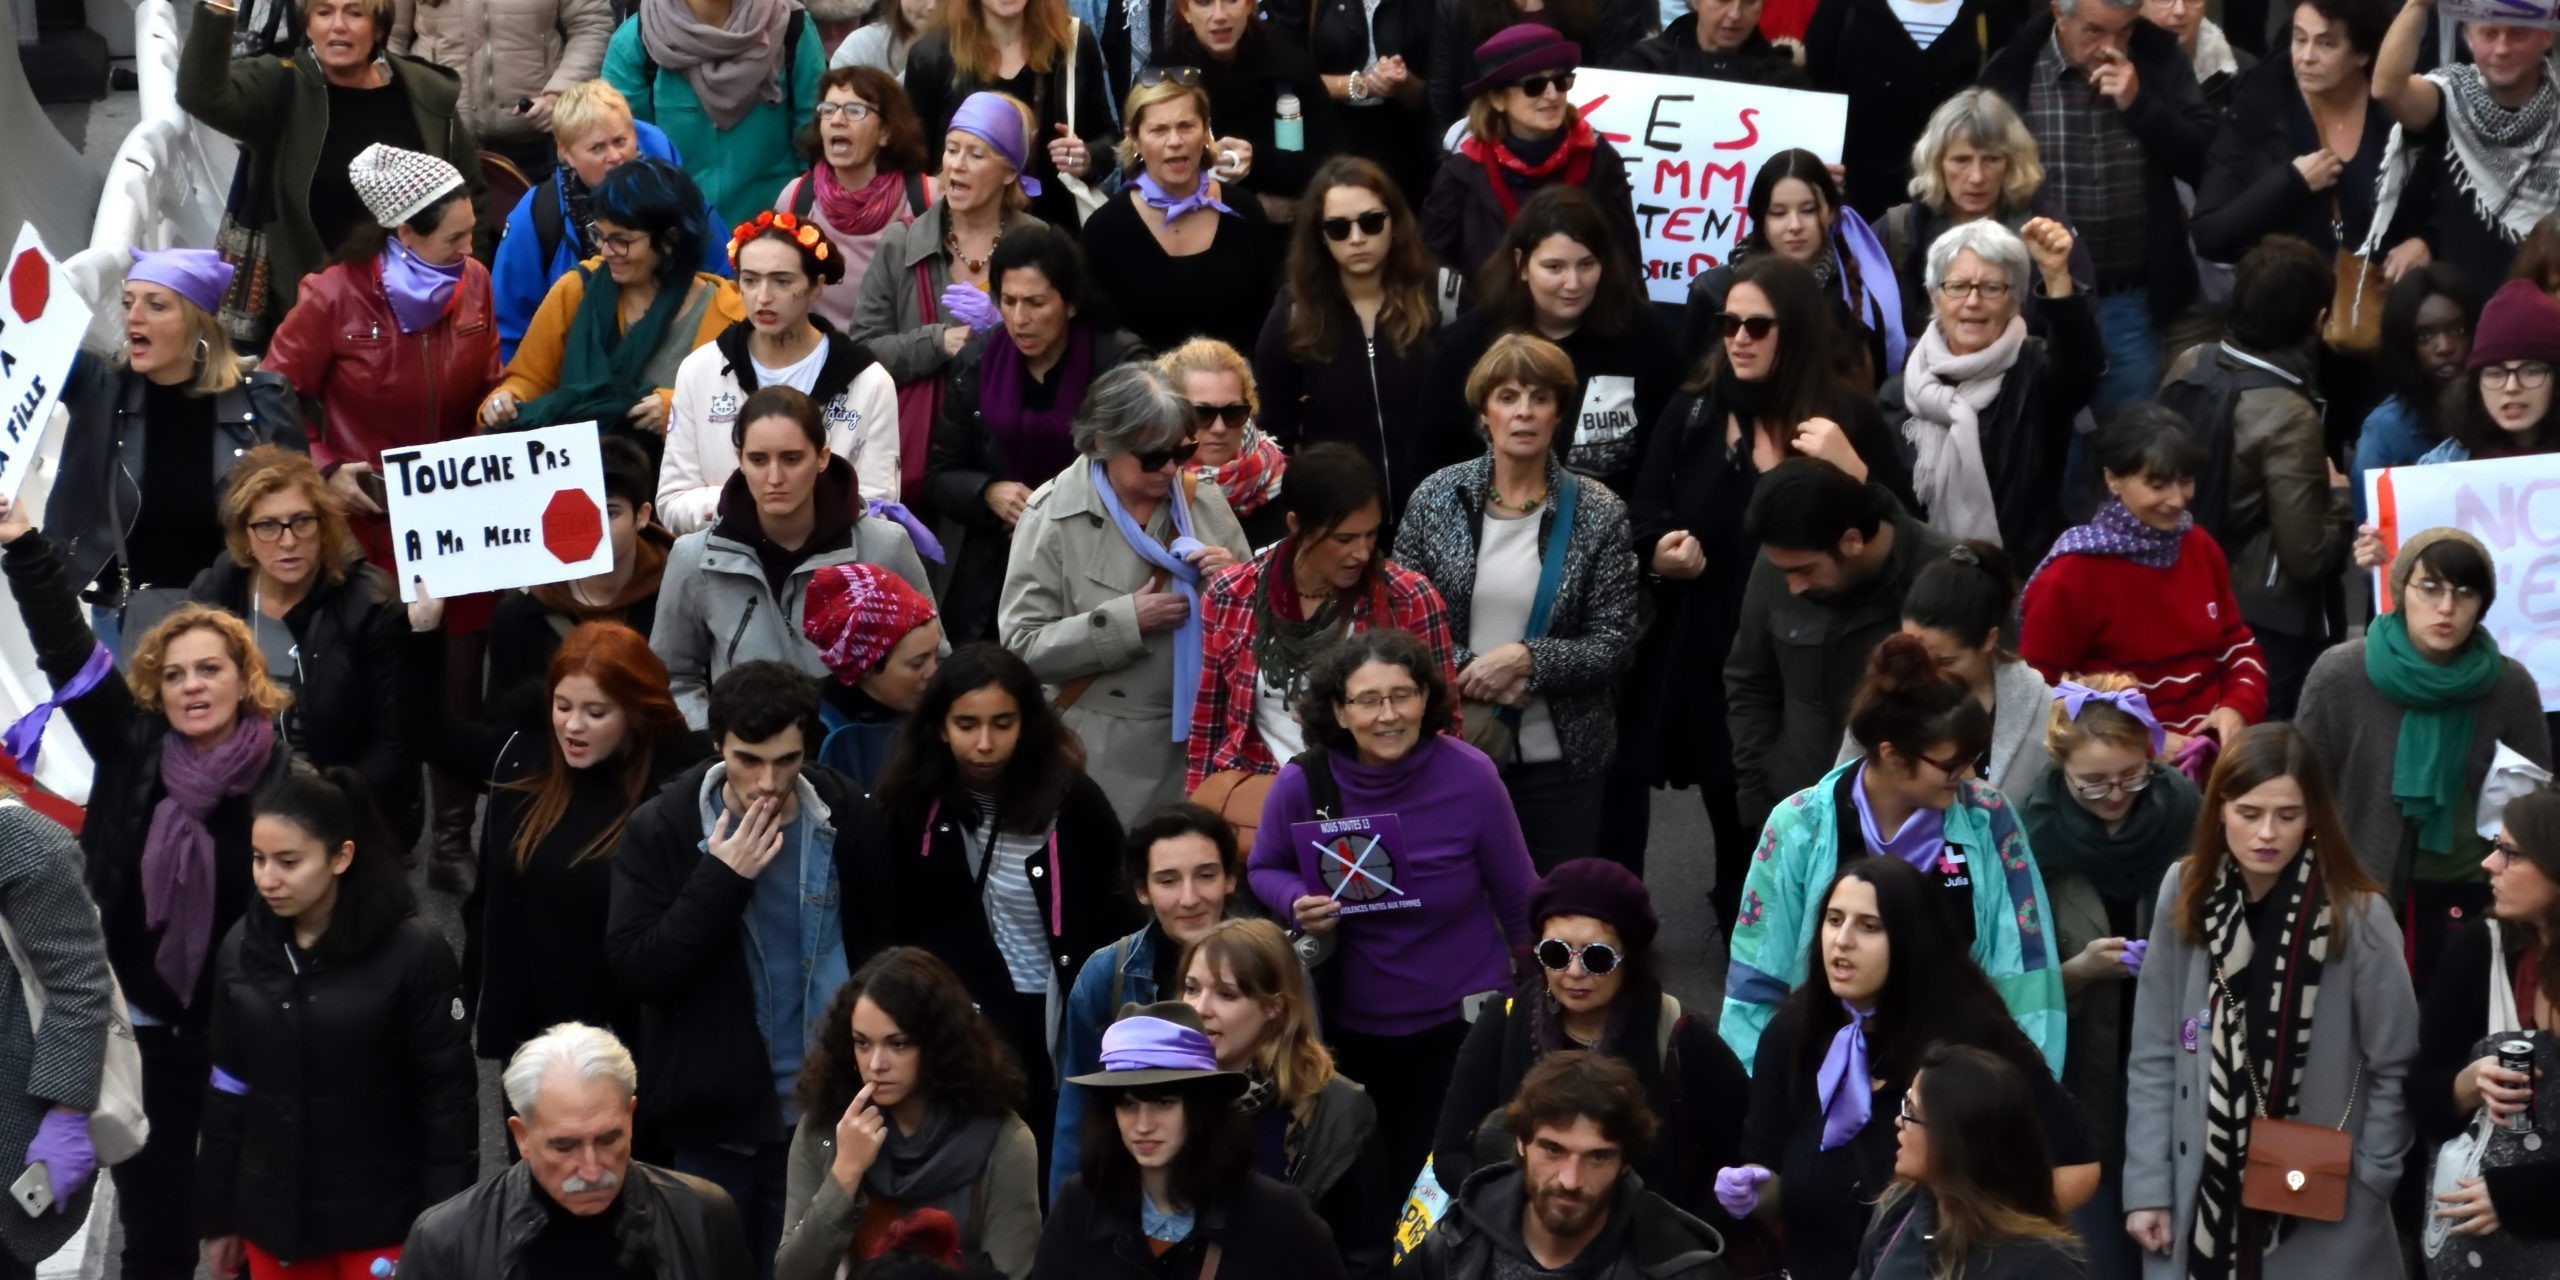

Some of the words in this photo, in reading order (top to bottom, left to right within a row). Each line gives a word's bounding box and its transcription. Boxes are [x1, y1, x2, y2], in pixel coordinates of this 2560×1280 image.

[825, 409, 861, 431] gang
[1583, 411, 1632, 430] BURN
[384, 450, 515, 496] TOUCHE
[526, 440, 571, 475] PAS
[405, 529, 422, 562] A
[436, 529, 464, 556] MA
[484, 525, 532, 547] MERE
[1320, 821, 1339, 833] NOUS
[1338, 818, 1362, 832] TOUTES
[1362, 818, 1371, 830] 13
[1944, 876, 1969, 888] Julia
[1340, 904, 1368, 915] VIOLENCES
[1368, 902, 1387, 911] FAITES
[1387, 901, 1399, 909] AUX
[1399, 898, 1422, 908] FEMMES
